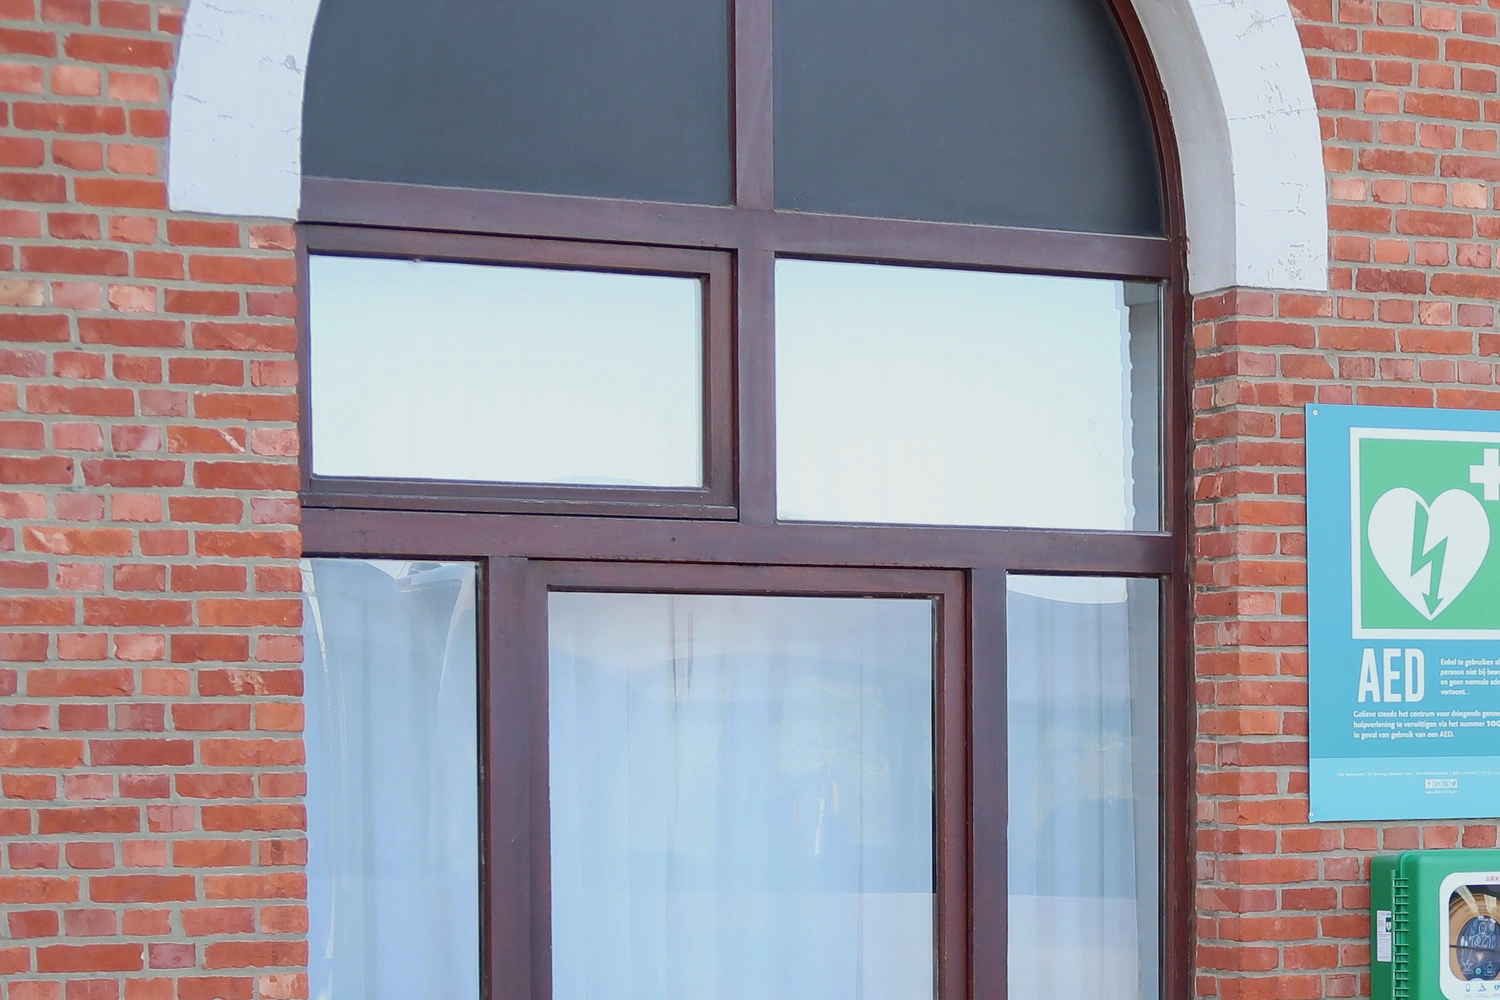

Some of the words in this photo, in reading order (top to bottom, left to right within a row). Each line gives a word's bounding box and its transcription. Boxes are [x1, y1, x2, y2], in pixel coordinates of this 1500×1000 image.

[1465, 658, 1493, 667] gebruiken
[1357, 647, 1426, 703] AED
[1440, 669, 1464, 677] persoon
[1449, 679, 1463, 687] geen
[1451, 710, 1481, 719] dringende
[1353, 721, 1395, 729] hulpverlening
[1404, 721, 1437, 729] verwittigen
[1361, 731, 1377, 740] geval
[1391, 731, 1413, 740] gebruik
